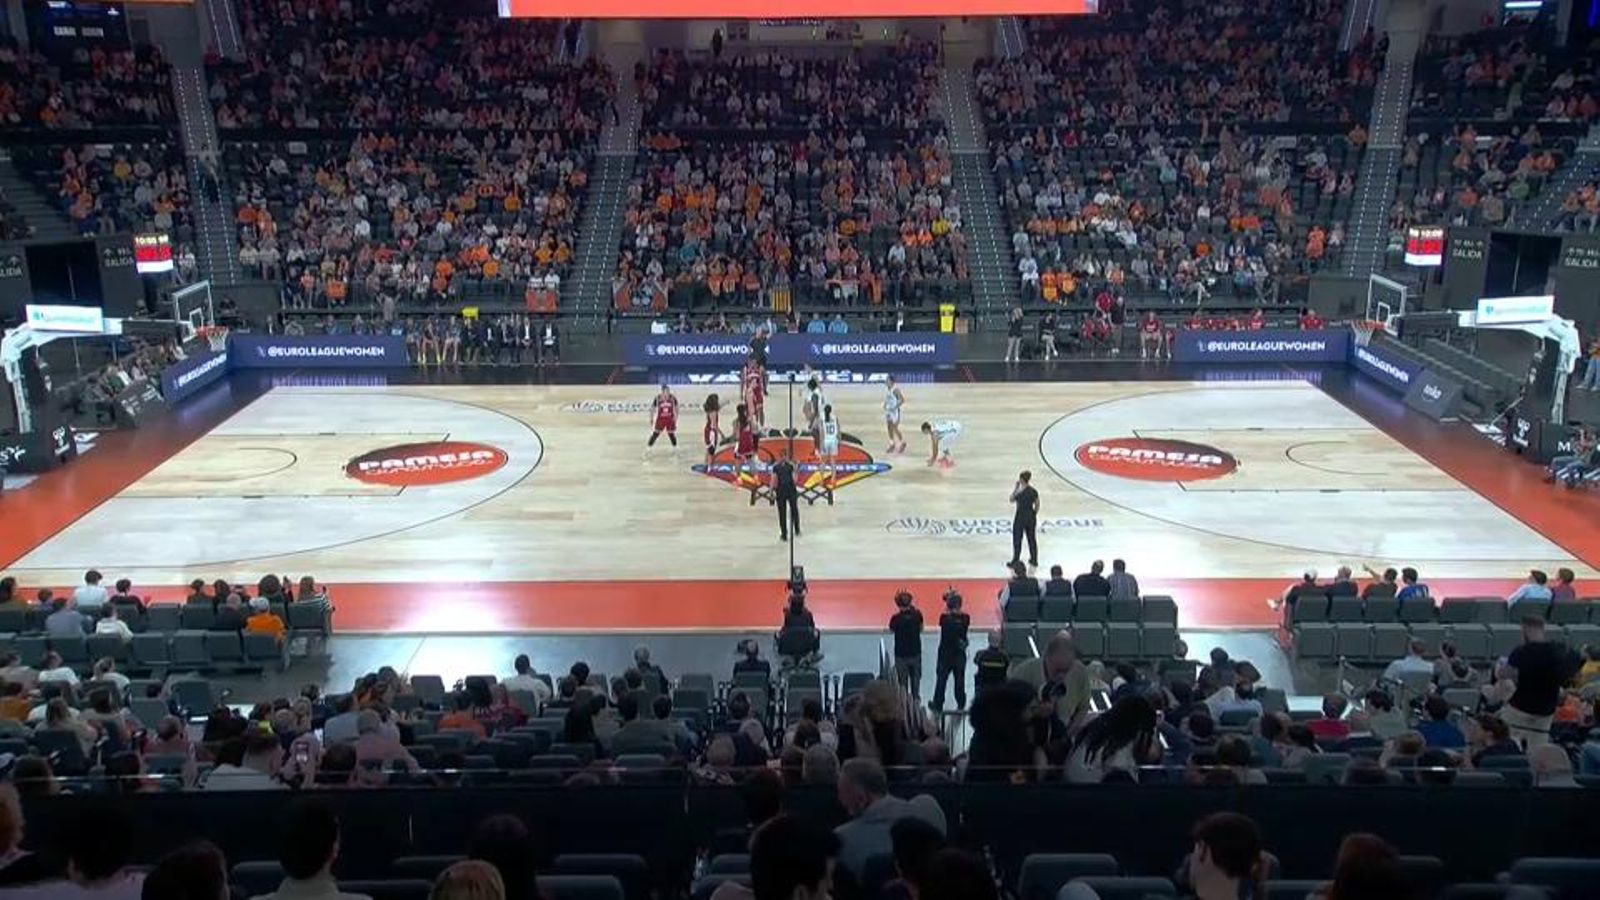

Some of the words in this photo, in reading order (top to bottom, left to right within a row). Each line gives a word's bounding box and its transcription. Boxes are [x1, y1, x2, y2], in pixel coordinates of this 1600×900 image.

[1452, 248, 1482, 259] SALIDA
[1565, 257, 1598, 267] SALIDA
[267, 345, 386, 357] @EUROLEAGUEWOMEN
[656, 344, 770, 355] @EUROLEAGUEWO
[822, 343, 936, 354] @EUROLEAGUEWOMEN
[1207, 341, 1326, 352] @EUROLEAGUEWOMEN
[687, 373, 890, 383] VAENCIA
[949, 518, 1104, 528] EUROAGUE
